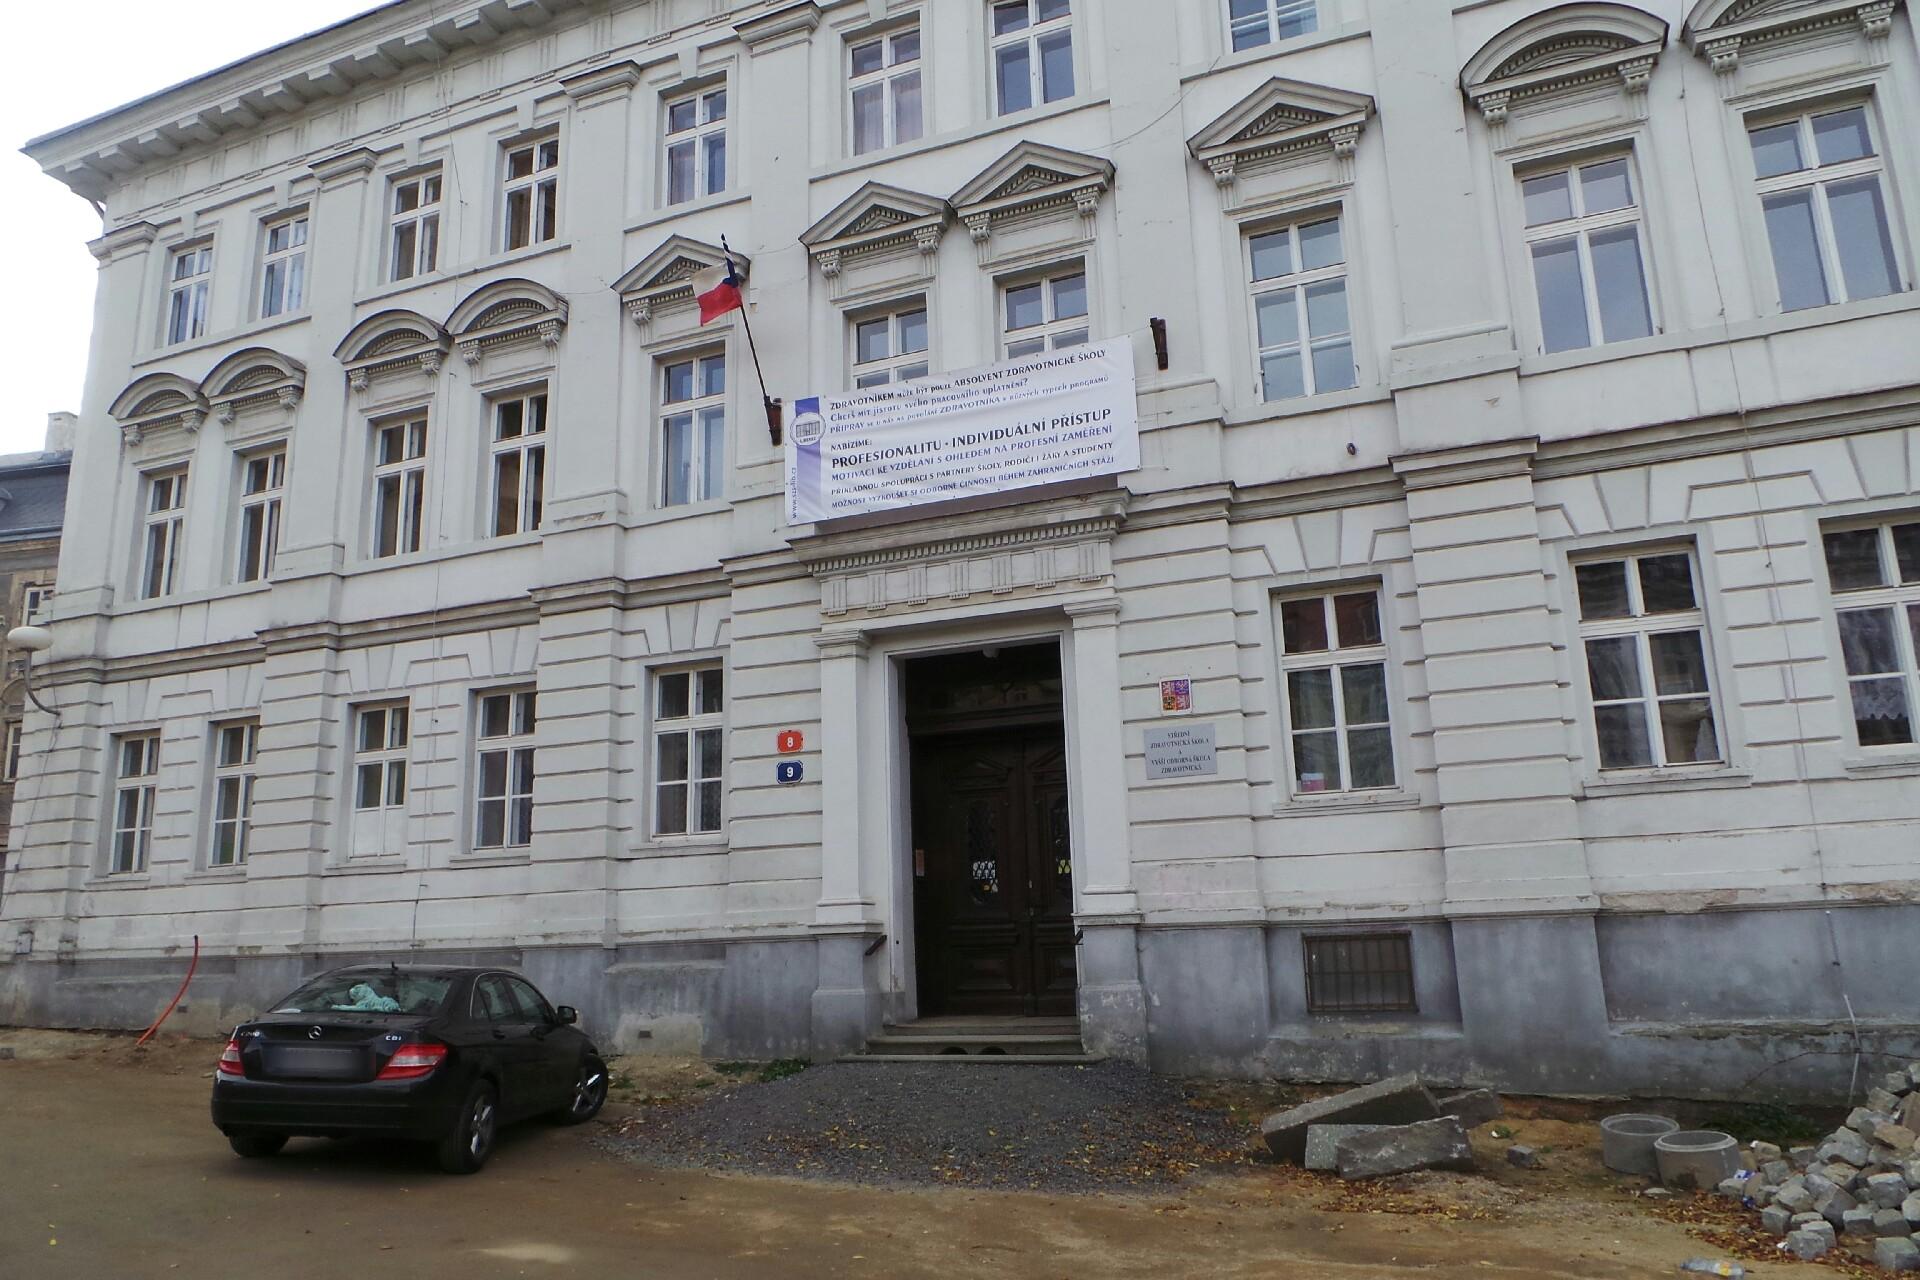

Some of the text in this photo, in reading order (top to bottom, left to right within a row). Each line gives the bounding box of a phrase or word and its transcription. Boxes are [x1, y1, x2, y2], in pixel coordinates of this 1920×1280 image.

[831, 393, 894, 410] ZDRAVOTNÍKEM
[954, 371, 1004, 386] ABSOLVENT
[1006, 356, 1075, 376] ZDRAVOTNICKÉ
[1078, 350, 1106, 361] ŠKOLY
[940, 397, 1000, 413] ZDRAVOTNÍKA
[831, 440, 872, 450] NABÍZÍME:
[831, 468, 874, 480] MOTIVACI
[877, 466, 887, 474] KE
[890, 457, 933, 470] VZDĚLÁNÍ
[945, 448, 991, 461] OHLEDEM
[995, 445, 1008, 453] NA
[1011, 435, 1058, 450] PROFESNÍ
[1061, 425, 1112, 441] ZAMĚŘENÍ
[832, 409, 1111, 468] PROFESIONALITU INDIVIDUÁLNÍ PŘÍSTUP
[831, 483, 878, 495] PŘÍKLADNOU
[881, 475, 928, 487] SPOLUPRÁCI
[936, 467, 975, 478] PARTNERY
[1072, 443, 1113, 455] STUDENTY
[832, 498, 865, 508] MOŽNOST
[959, 476, 996, 488] ČINNOSTI
[998, 472, 1024, 480] BĚHEM
[1027, 460, 1089, 476] ZAHRANIČNÍCH
[787, 736, 794, 748] 8
[786, 766, 794, 778] 9
